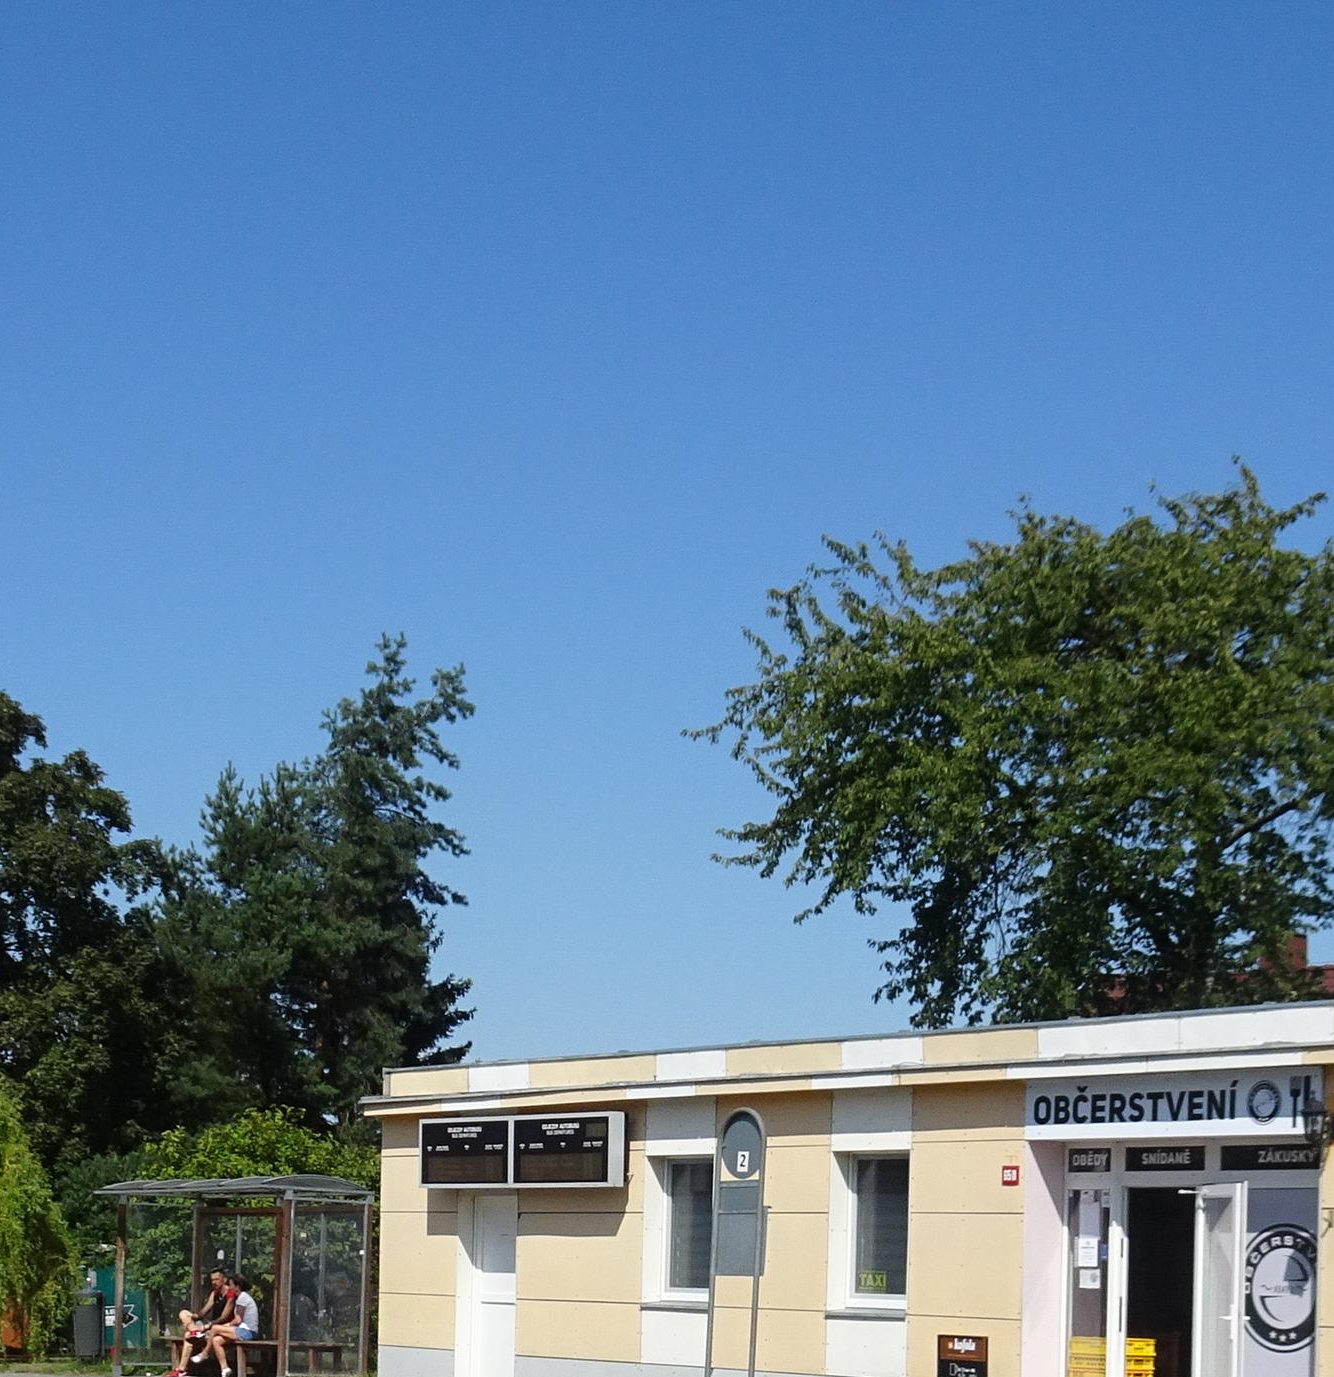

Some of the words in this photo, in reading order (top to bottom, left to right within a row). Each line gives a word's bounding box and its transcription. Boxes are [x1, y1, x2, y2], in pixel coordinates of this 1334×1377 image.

[1033, 1080, 1239, 1125] OBČERSTVENÍ
[739, 1154, 746, 1168] 2
[1141, 1148, 1191, 1165] SNÍDANĚ
[1258, 1147, 1314, 1163] ZÁKUSKY
[858, 1272, 887, 1288] TAXI
